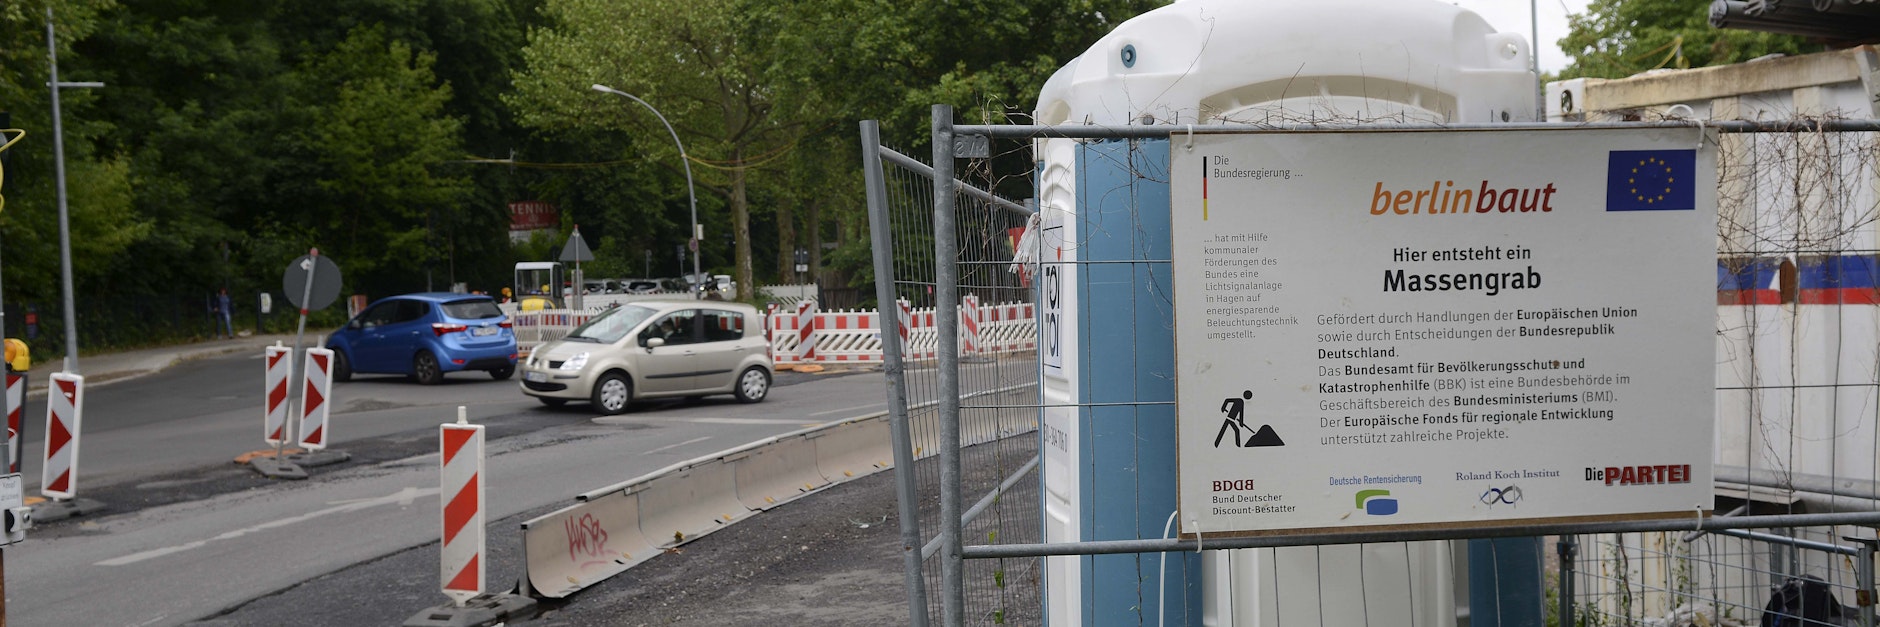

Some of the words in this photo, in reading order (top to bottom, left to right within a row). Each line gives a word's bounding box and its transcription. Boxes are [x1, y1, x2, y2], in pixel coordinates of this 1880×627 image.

[1214, 155, 1230, 166] Die
[1214, 168, 1291, 181] Bundesregierung
[507, 203, 556, 215] TENNIS
[1214, 234, 1229, 243] hat
[1231, 234, 1246, 242] mit
[1247, 233, 1268, 242] Hilfe
[1204, 246, 1259, 255] kommunaler
[1393, 247, 1428, 263] Hier
[1431, 246, 1502, 262] entsteht
[1506, 245, 1531, 261] ein
[1204, 258, 1259, 268] Förderungen
[1261, 257, 1278, 266] des
[1205, 271, 1238, 279] Bundes
[1239, 270, 1259, 278] eine
[1205, 281, 1283, 292] Lichtsignalanlage
[1384, 266, 1541, 296] Massengrab
[1046, 265, 1060, 310] TOI
[1205, 295, 1214, 303] in
[1216, 295, 1244, 305] Hagen
[1246, 294, 1261, 302] auf
[1206, 305, 1280, 317] energiesparende
[1316, 313, 1375, 326] Gefördert
[1378, 312, 1413, 324] durch
[1416, 311, 1490, 325] Handlungen
[1493, 310, 1514, 321] der
[1516, 308, 1599, 323] Europäischen
[1602, 307, 1638, 318] Union
[1206, 317, 1299, 328] Beleuchtungstechnik
[1046, 312, 1059, 357] TOI
[1207, 330, 1256, 341] umgestellt.
[1317, 331, 1353, 343] sowie
[1356, 330, 1391, 342] durch
[1394, 328, 1493, 341] Entscheidungen
[1496, 327, 1516, 338] der
[1519, 324, 1615, 339] Bundesrepublik
[1317, 346, 1400, 360] Deutschland.
[1318, 366, 1341, 377] Das
[1344, 364, 1415, 376] Bundesamt
[1416, 363, 1435, 374] für
[1562, 358, 1585, 370] und
[1319, 380, 1430, 395] Katastrophenhilfe
[1433, 378, 1467, 393] (BBK)
[1470, 378, 1485, 389] ist
[1488, 377, 1514, 389] eine
[1517, 374, 1613, 388] Bundesbehörde
[1615, 374, 1630, 385] im
[1319, 397, 1425, 411] Geschäftsbereich
[1428, 396, 1451, 408] des
[1453, 392, 1579, 407] Bundesministeriums
[1581, 391, 1618, 404] (BMI).
[1320, 417, 1341, 428] Der
[1344, 414, 1420, 430] Europäische
[1422, 413, 1459, 425] Fonds
[1461, 412, 1479, 423] für
[1481, 410, 1538, 425] regionale
[1541, 408, 1614, 422] Entwicklung
[1320, 433, 1387, 446] unterstützt
[1390, 430, 1453, 443] zahlreiche
[1455, 429, 1509, 443] Projekte.
[1329, 476, 1362, 486] Deutsche
[1363, 475, 1422, 485] Rentensicherung
[1455, 471, 1492, 481] Roland
[1494, 470, 1521, 480] Koch
[1522, 469, 1560, 479] Institut
[1584, 467, 1604, 482] Die
[1605, 464, 1691, 486] PARTEI
[1212, 495, 1235, 504] Bund
[1237, 493, 1283, 503] Deutscher
[1212, 504, 1296, 516] Discount-Bestatter
